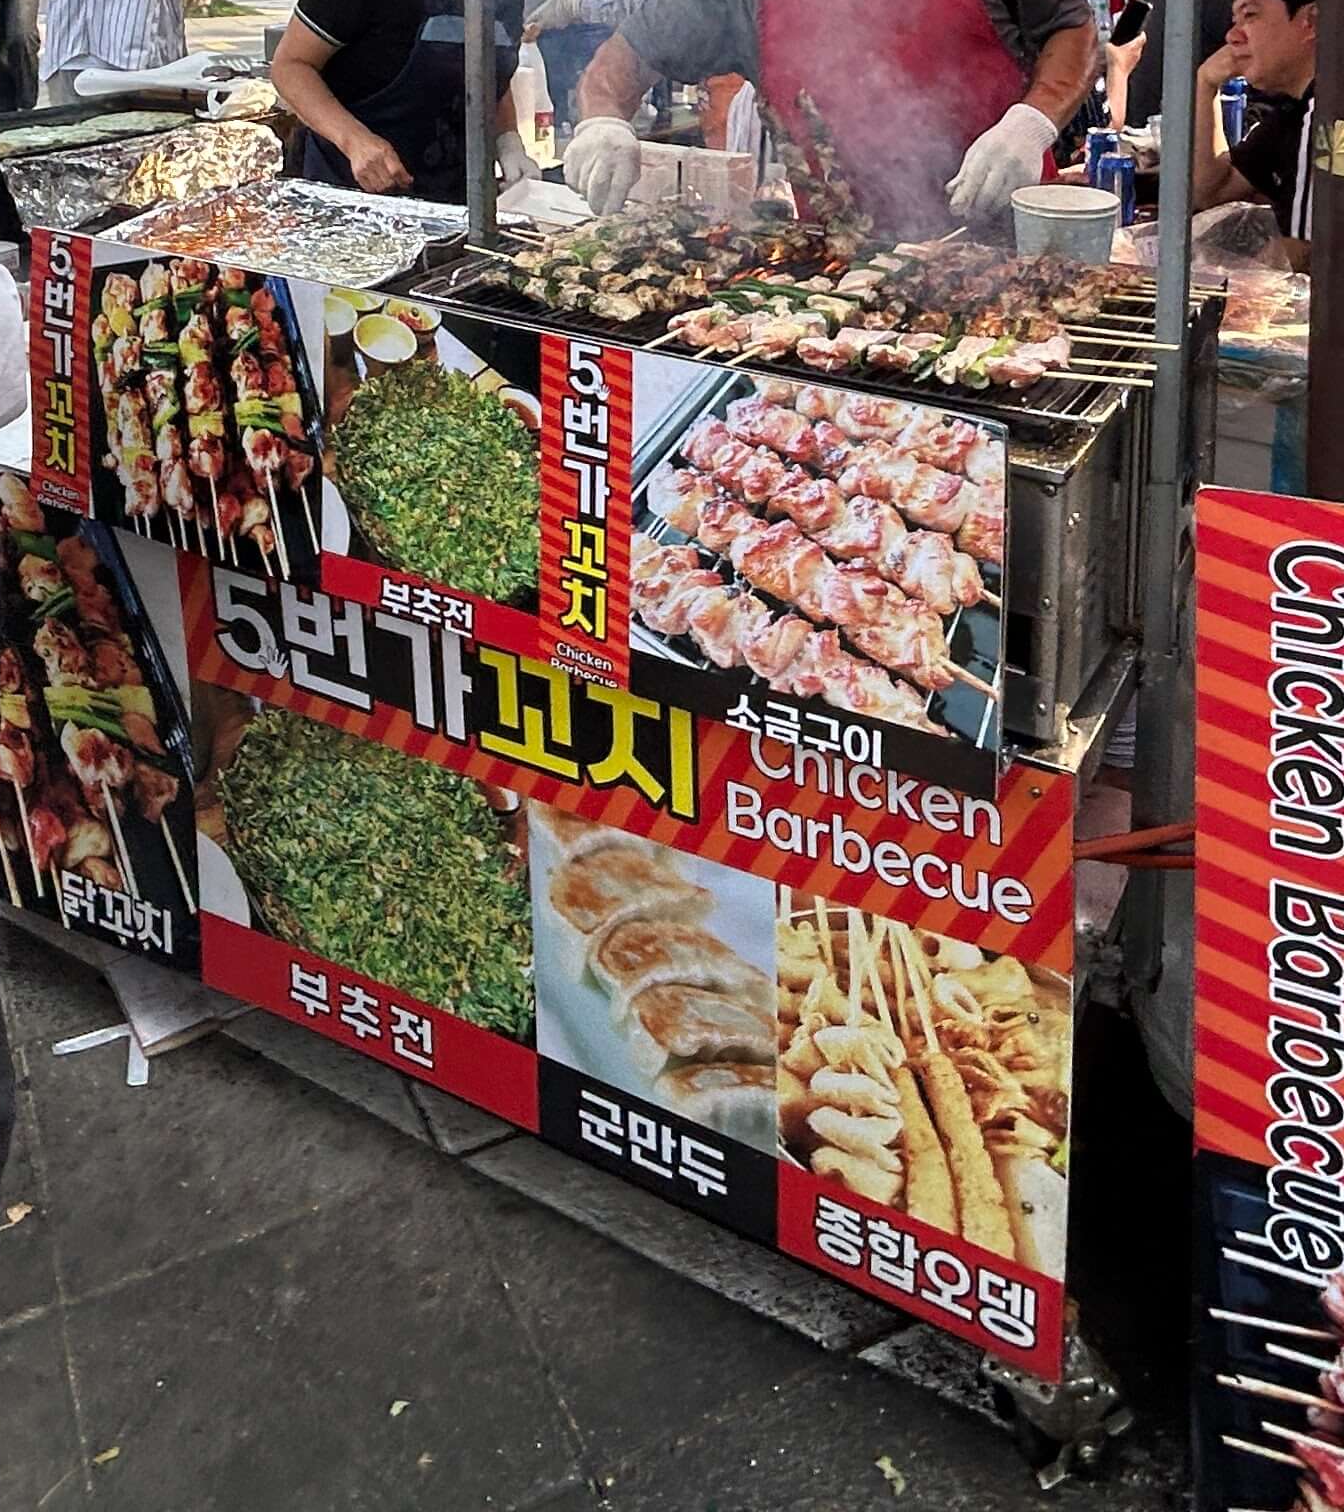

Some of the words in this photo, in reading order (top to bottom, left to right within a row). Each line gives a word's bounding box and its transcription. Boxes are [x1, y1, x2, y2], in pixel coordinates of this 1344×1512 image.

[42, 233, 76, 475] 5번가꼬치
[560, 341, 610, 641] 5번가꼬치
[382, 578, 473, 638] 부추전
[556, 641, 613, 672] Chicken
[213, 567, 697, 819] 5번가꼬치
[724, 693, 883, 769] 소금구이
[749, 731, 1002, 847] Chicken
[725, 780, 1034, 925] Barbecue
[60, 868, 174, 955] 닭꼬치
[289, 961, 435, 1070] 부추전
[578, 1089, 729, 1197] 군만두
[814, 1195, 1036, 1348] 종합오뎅
